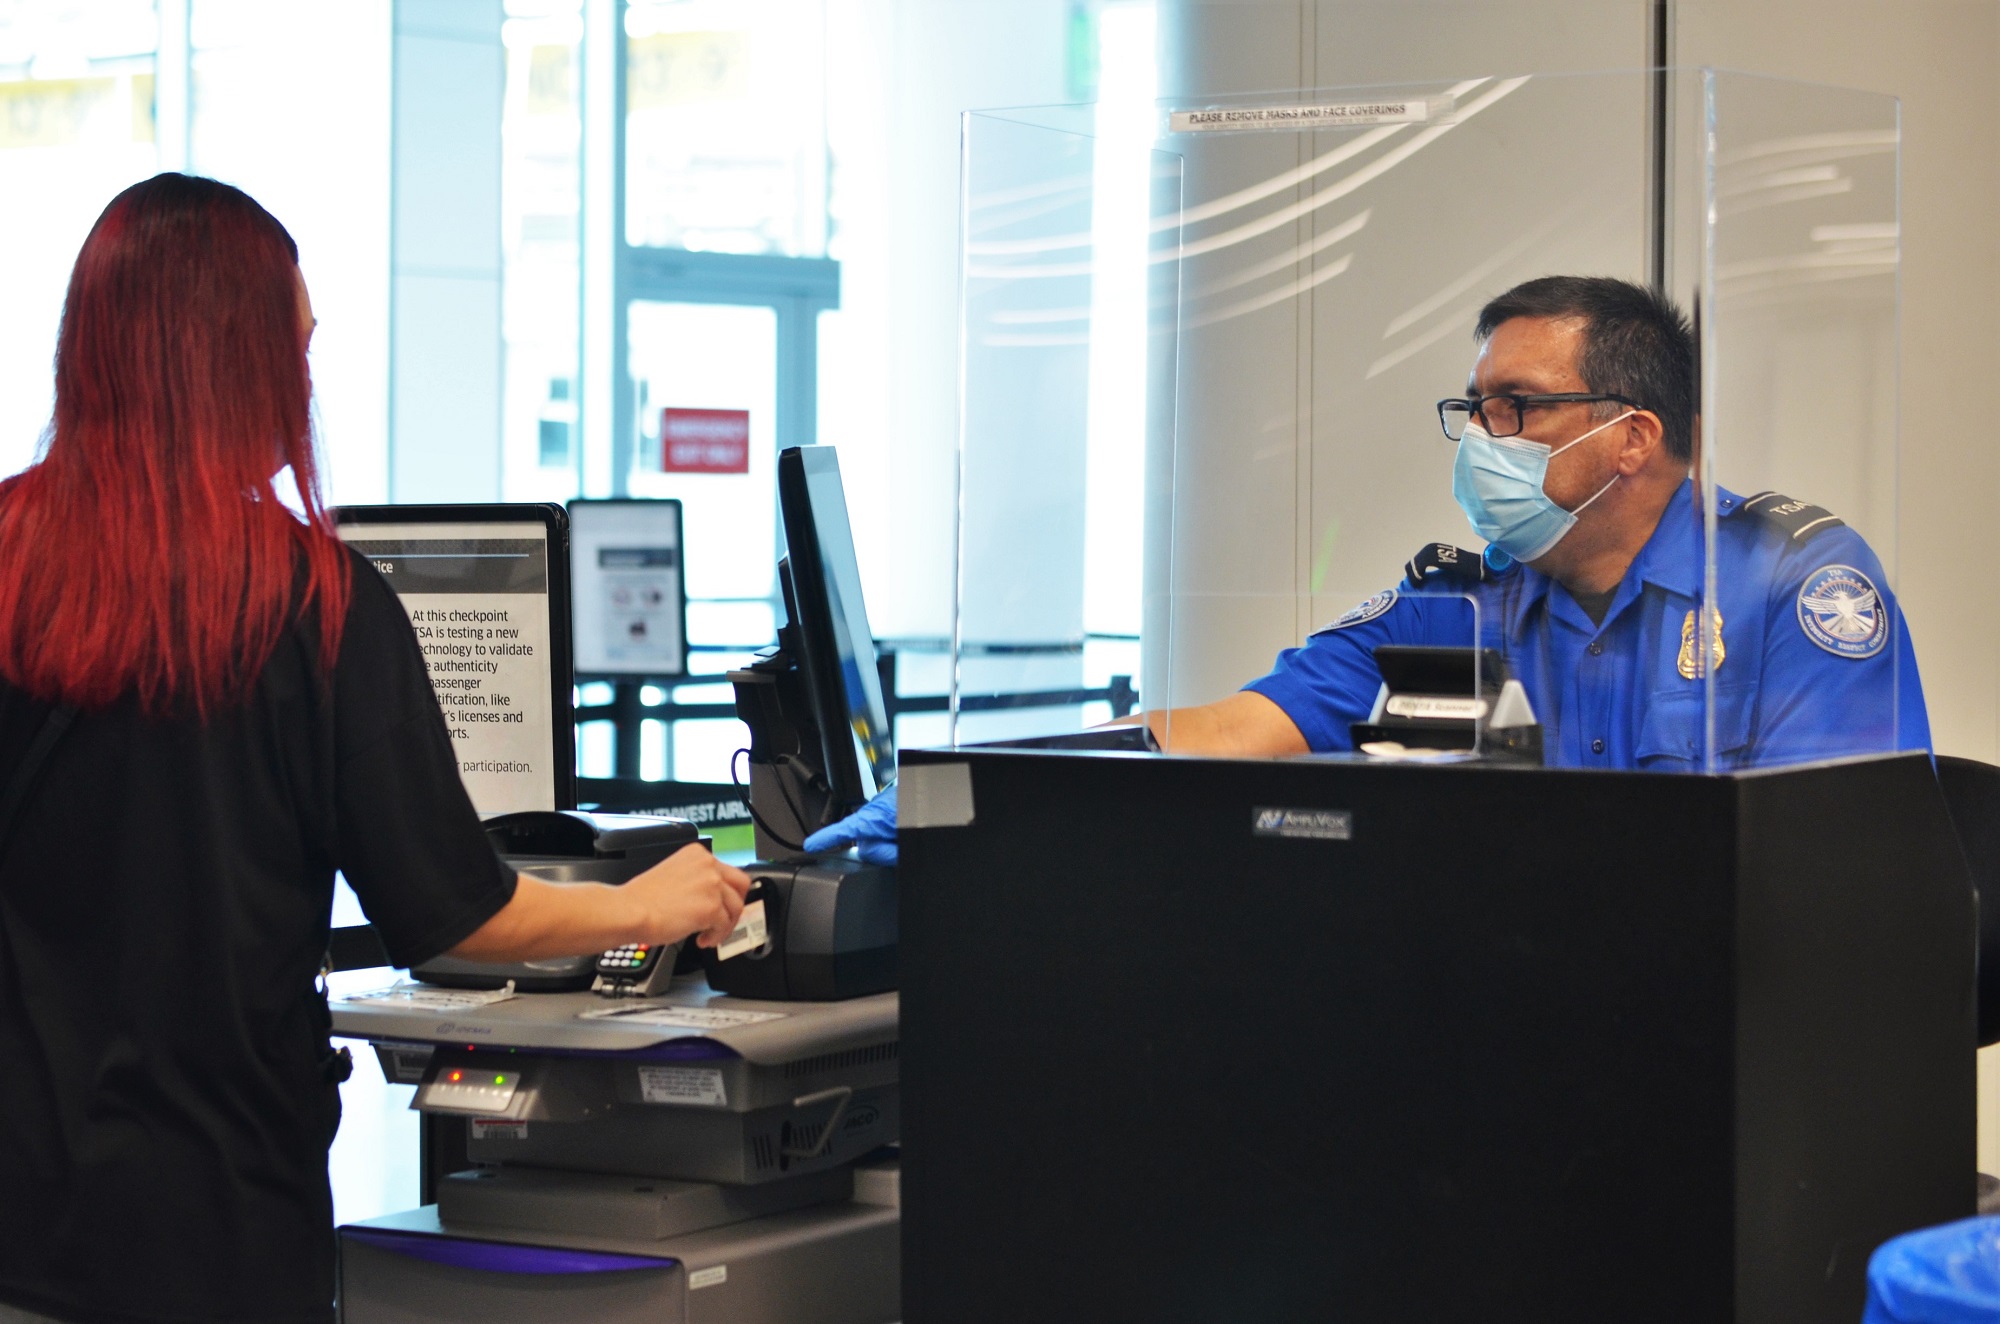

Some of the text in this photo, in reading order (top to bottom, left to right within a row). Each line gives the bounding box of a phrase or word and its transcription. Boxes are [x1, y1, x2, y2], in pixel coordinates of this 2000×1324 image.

[1189, 112, 1222, 124] PLEASE
[1225, 110, 1263, 121] REMOVE
[1266, 108, 1298, 120] MASKS
[1301, 108, 1320, 118] AND
[1323, 106, 1346, 117] FACE
[1349, 104, 1406, 116] COVERINGS
[1769, 500, 1811, 515] TSA
[1437, 544, 1457, 564] TSA
[412, 609, 509, 623] At this checkpoint
[413, 626, 519, 641] TSA is testing a new
[420, 643, 533, 657] echnology to validate
[434, 659, 498, 674] authenticity
[437, 693, 511, 707] tification, like
[458, 710, 500, 723] licenses
[502, 711, 523, 723] and
[463, 760, 533, 774] participation.
